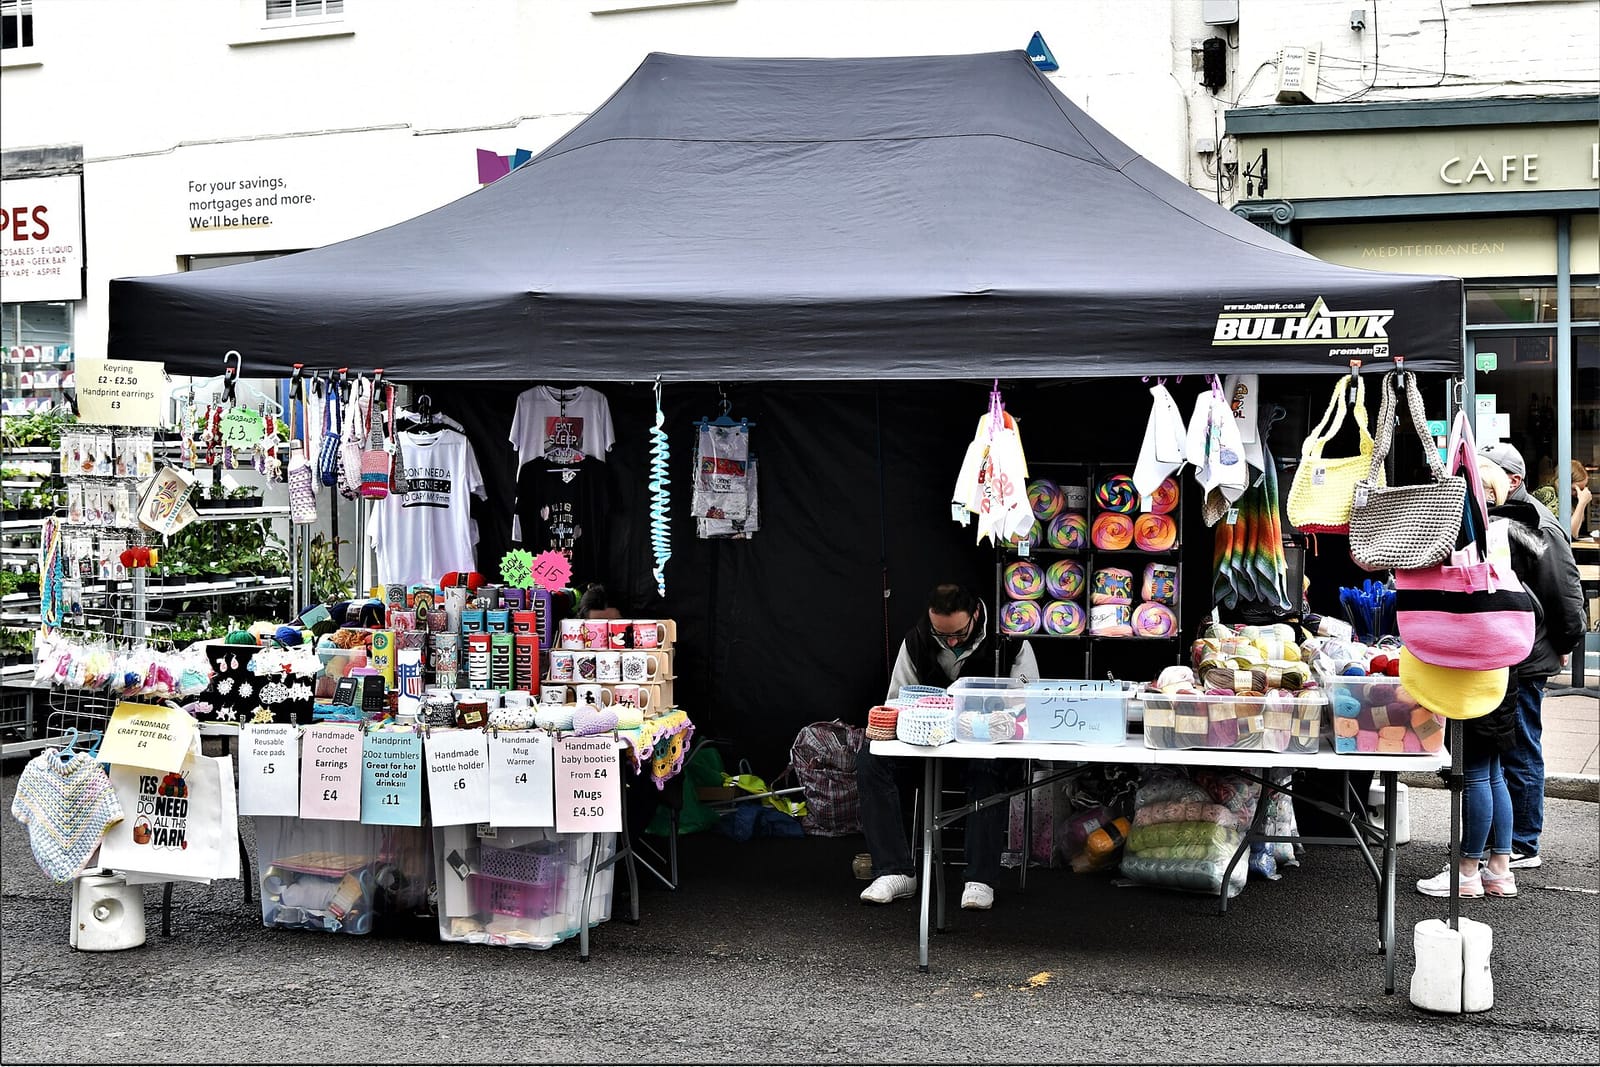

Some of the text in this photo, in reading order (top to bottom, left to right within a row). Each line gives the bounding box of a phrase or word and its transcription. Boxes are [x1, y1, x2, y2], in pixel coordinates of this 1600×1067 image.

[1439, 153, 1540, 186] CAFE
[188, 175, 287, 195] For your savings,
[189, 193, 316, 213] mortgages and more.
[189, 213, 273, 229] We'll be here.
[0, 247, 35, 256] OSABLES
[1361, 241, 1505, 258] MEDITERRANEAN
[11, 258, 25, 267] BAR
[32, 257, 51, 266] GEEK
[52, 256, 67, 265] BAR
[13, 268, 29, 277] VAPE
[37, 267, 61, 276] ASPIRE
[1223, 302, 1306, 311] www.bulhawk.co.uk
[1213, 315, 1393, 340] BULHAWK
[1374, 346, 1388, 355] 32
[103, 363, 134, 374] Keyring
[98, 375, 108, 384] £2
[114, 376, 138, 385] £2.50
[82, 387, 154, 400] Handprint earrings
[111, 401, 121, 409] £3
[228, 425, 246, 440] £3
[425, 467, 445, 478] NEED
[502, 554, 519, 573] GLOW
[534, 560, 565, 582] £15
[469, 641, 488, 689] PRIME
[493, 644, 510, 692] PRIME
[516, 644, 534, 692] PRIME
[130, 719, 171, 731] HANDMADE
[117, 727, 177, 742] CRAFT TOTE BAGS
[311, 731, 355, 740] Handmade
[501, 736, 540, 744] Handmade
[137, 740, 148, 748] £4
[254, 738, 285, 746] Reusable
[371, 736, 411, 746] Handprint
[565, 742, 611, 750] Handmade
[252, 748, 286, 757] Face pads
[316, 745, 348, 754] Crochet
[363, 750, 420, 760] 20oz tumblers
[434, 748, 479, 760] Handmade
[512, 747, 529, 756] Mug
[315, 759, 348, 769] Earrings
[366, 761, 388, 769] Great
[403, 762, 416, 770] hot
[561, 755, 616, 765] baby booties
[263, 763, 275, 774] £5
[431, 761, 485, 773] bottle holder
[320, 773, 342, 782] From
[374, 770, 407, 779] and cold
[515, 772, 528, 784] £4
[570, 768, 608, 779] From £4
[139, 775, 159, 795] YES
[453, 778, 466, 790] £6
[322, 789, 338, 801] £4
[381, 793, 400, 805] £11
[573, 789, 602, 801] Mugs
[136, 797, 188, 818] DO NEED
[573, 806, 604, 817] £4.50
[153, 818, 187, 829] ALL THIS
[153, 827, 187, 847] YARN
